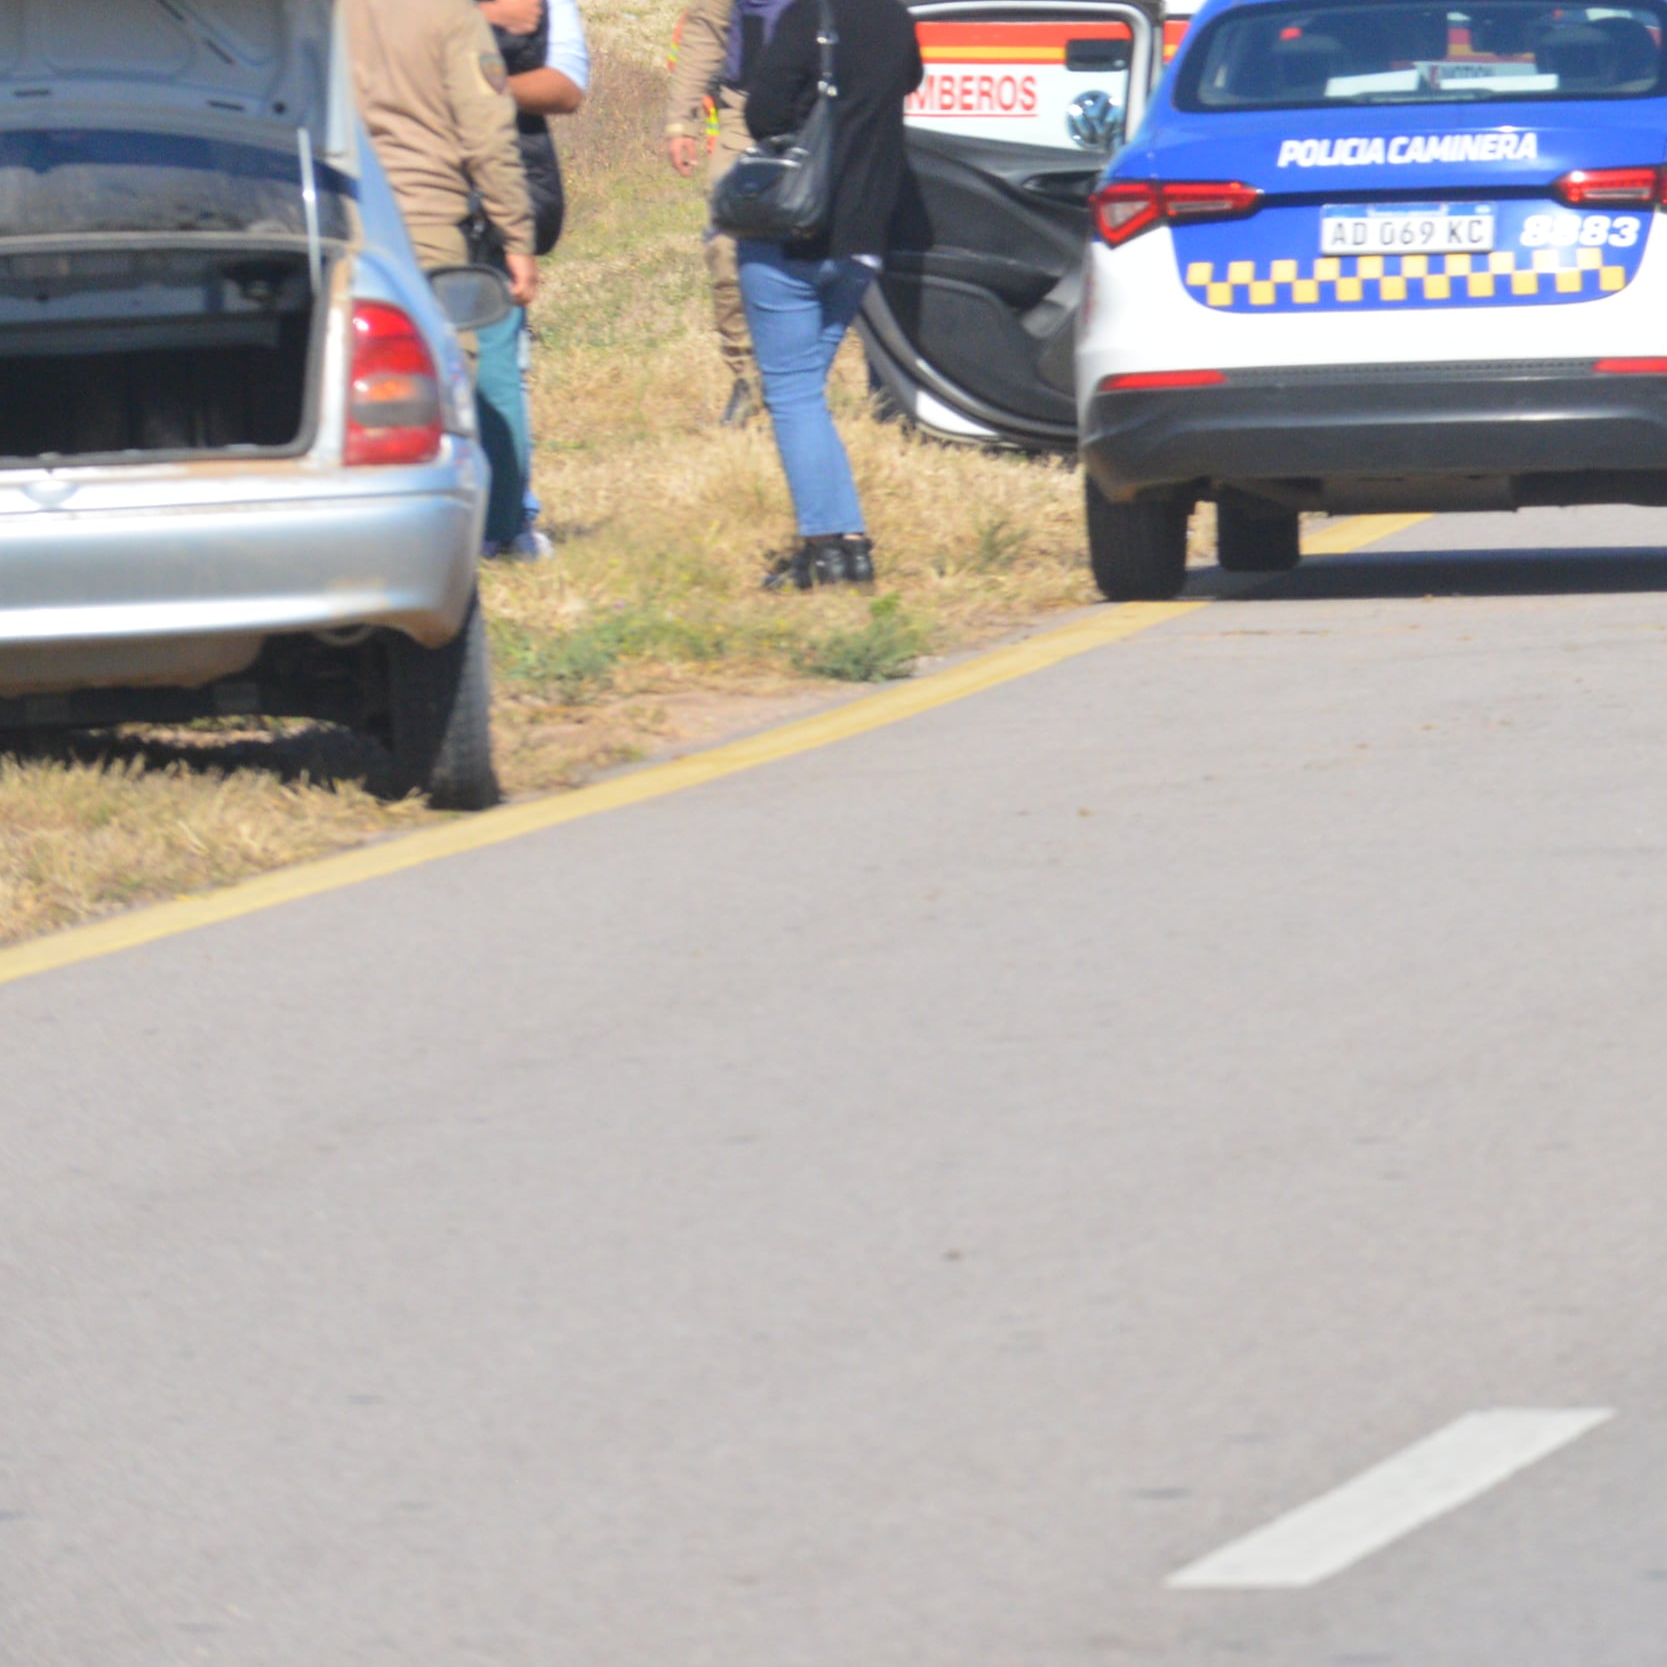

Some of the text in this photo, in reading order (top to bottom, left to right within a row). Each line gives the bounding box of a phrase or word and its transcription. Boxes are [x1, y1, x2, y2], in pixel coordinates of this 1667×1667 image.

[1277, 132, 1538, 168] POLICIA CAMINERA
[1331, 219, 1484, 246] AD 069 KC
[1519, 214, 1641, 248] 8883
